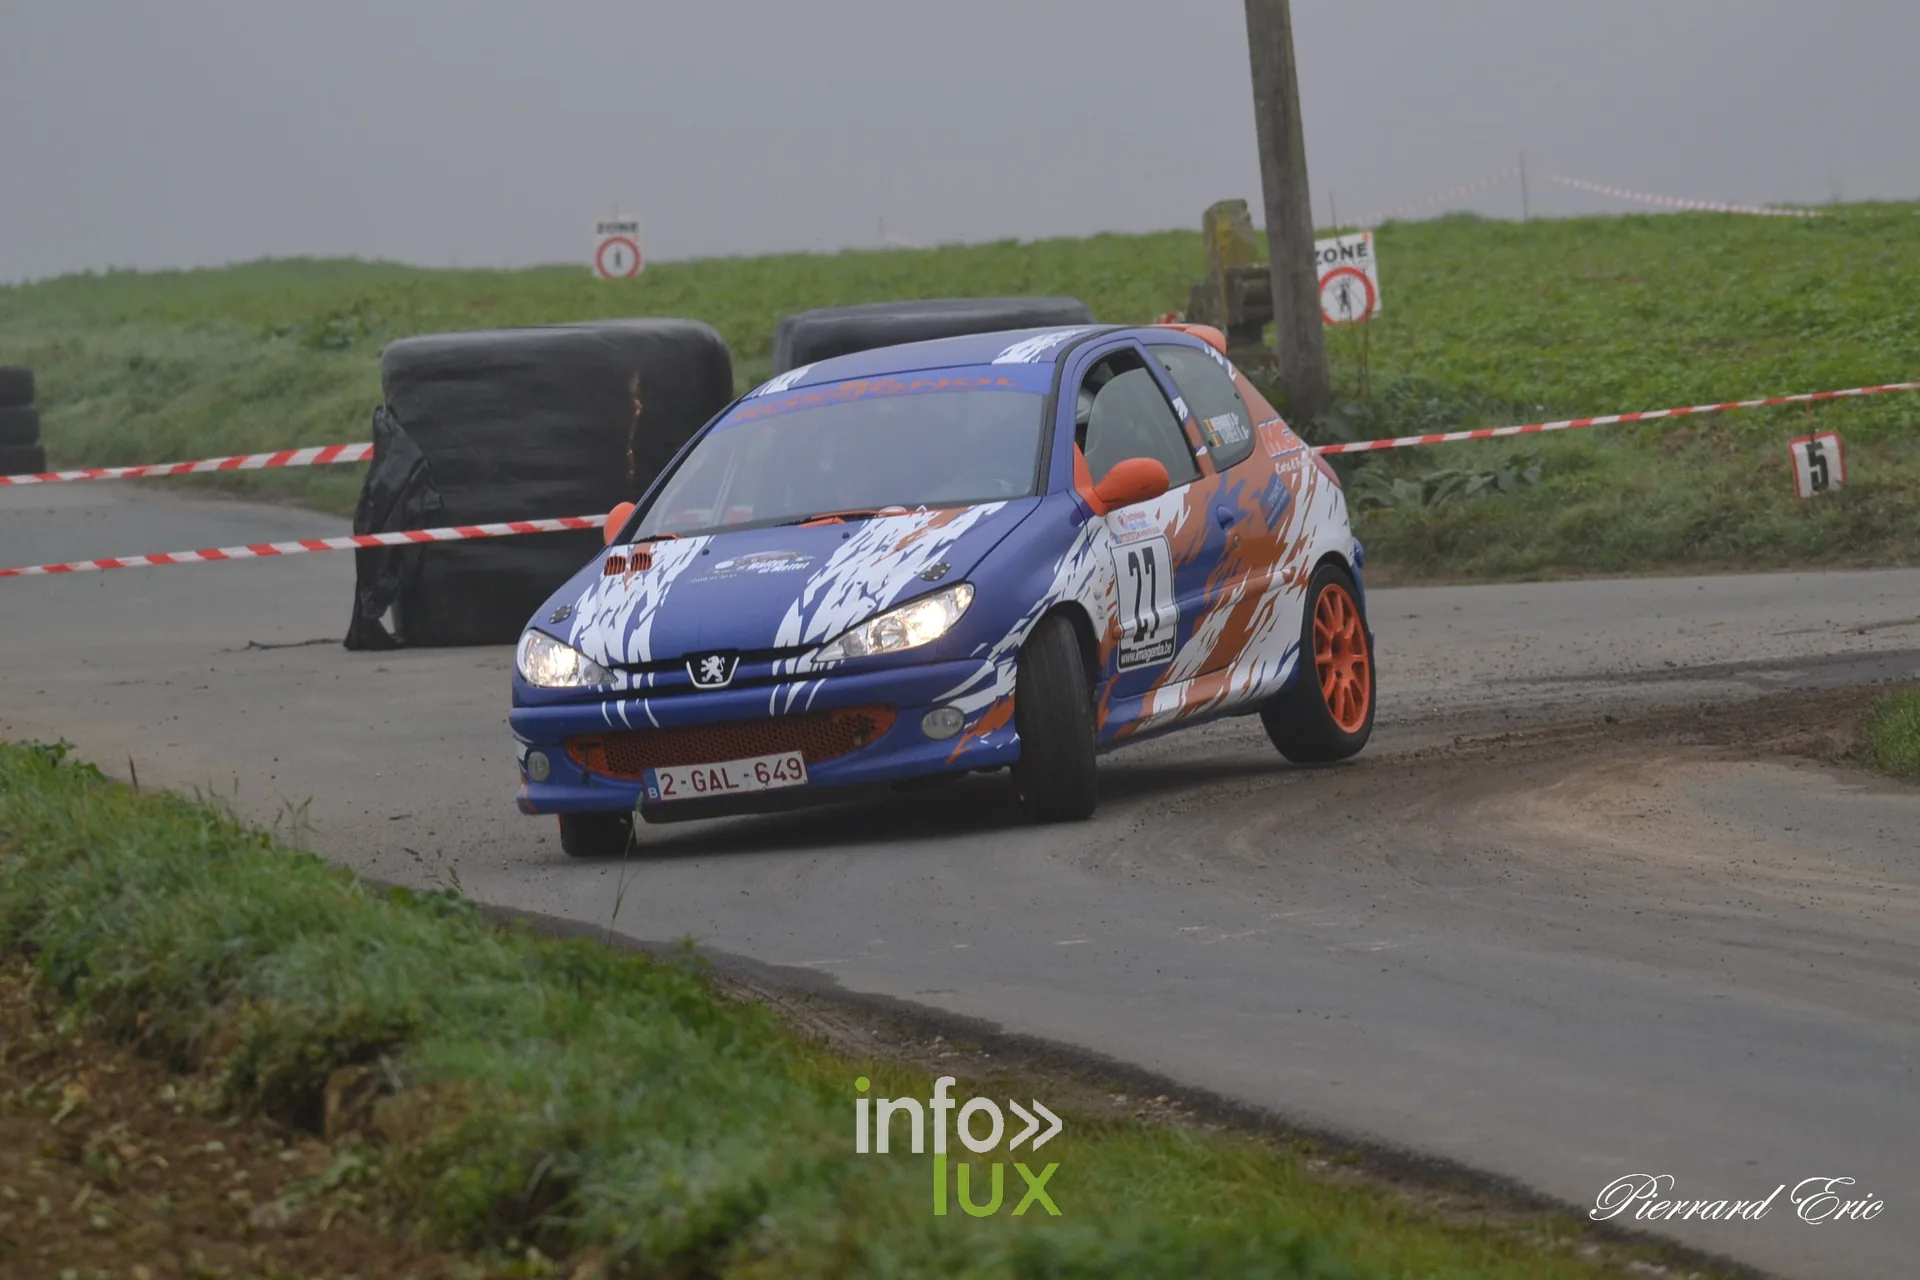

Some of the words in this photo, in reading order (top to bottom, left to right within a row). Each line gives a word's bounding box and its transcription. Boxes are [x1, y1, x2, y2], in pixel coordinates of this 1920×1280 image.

[1804, 440, 1830, 492] 5
[1127, 545, 1160, 644] 27
[648, 787, 658, 799] B
[659, 756, 804, 796] 2-GAL-649
